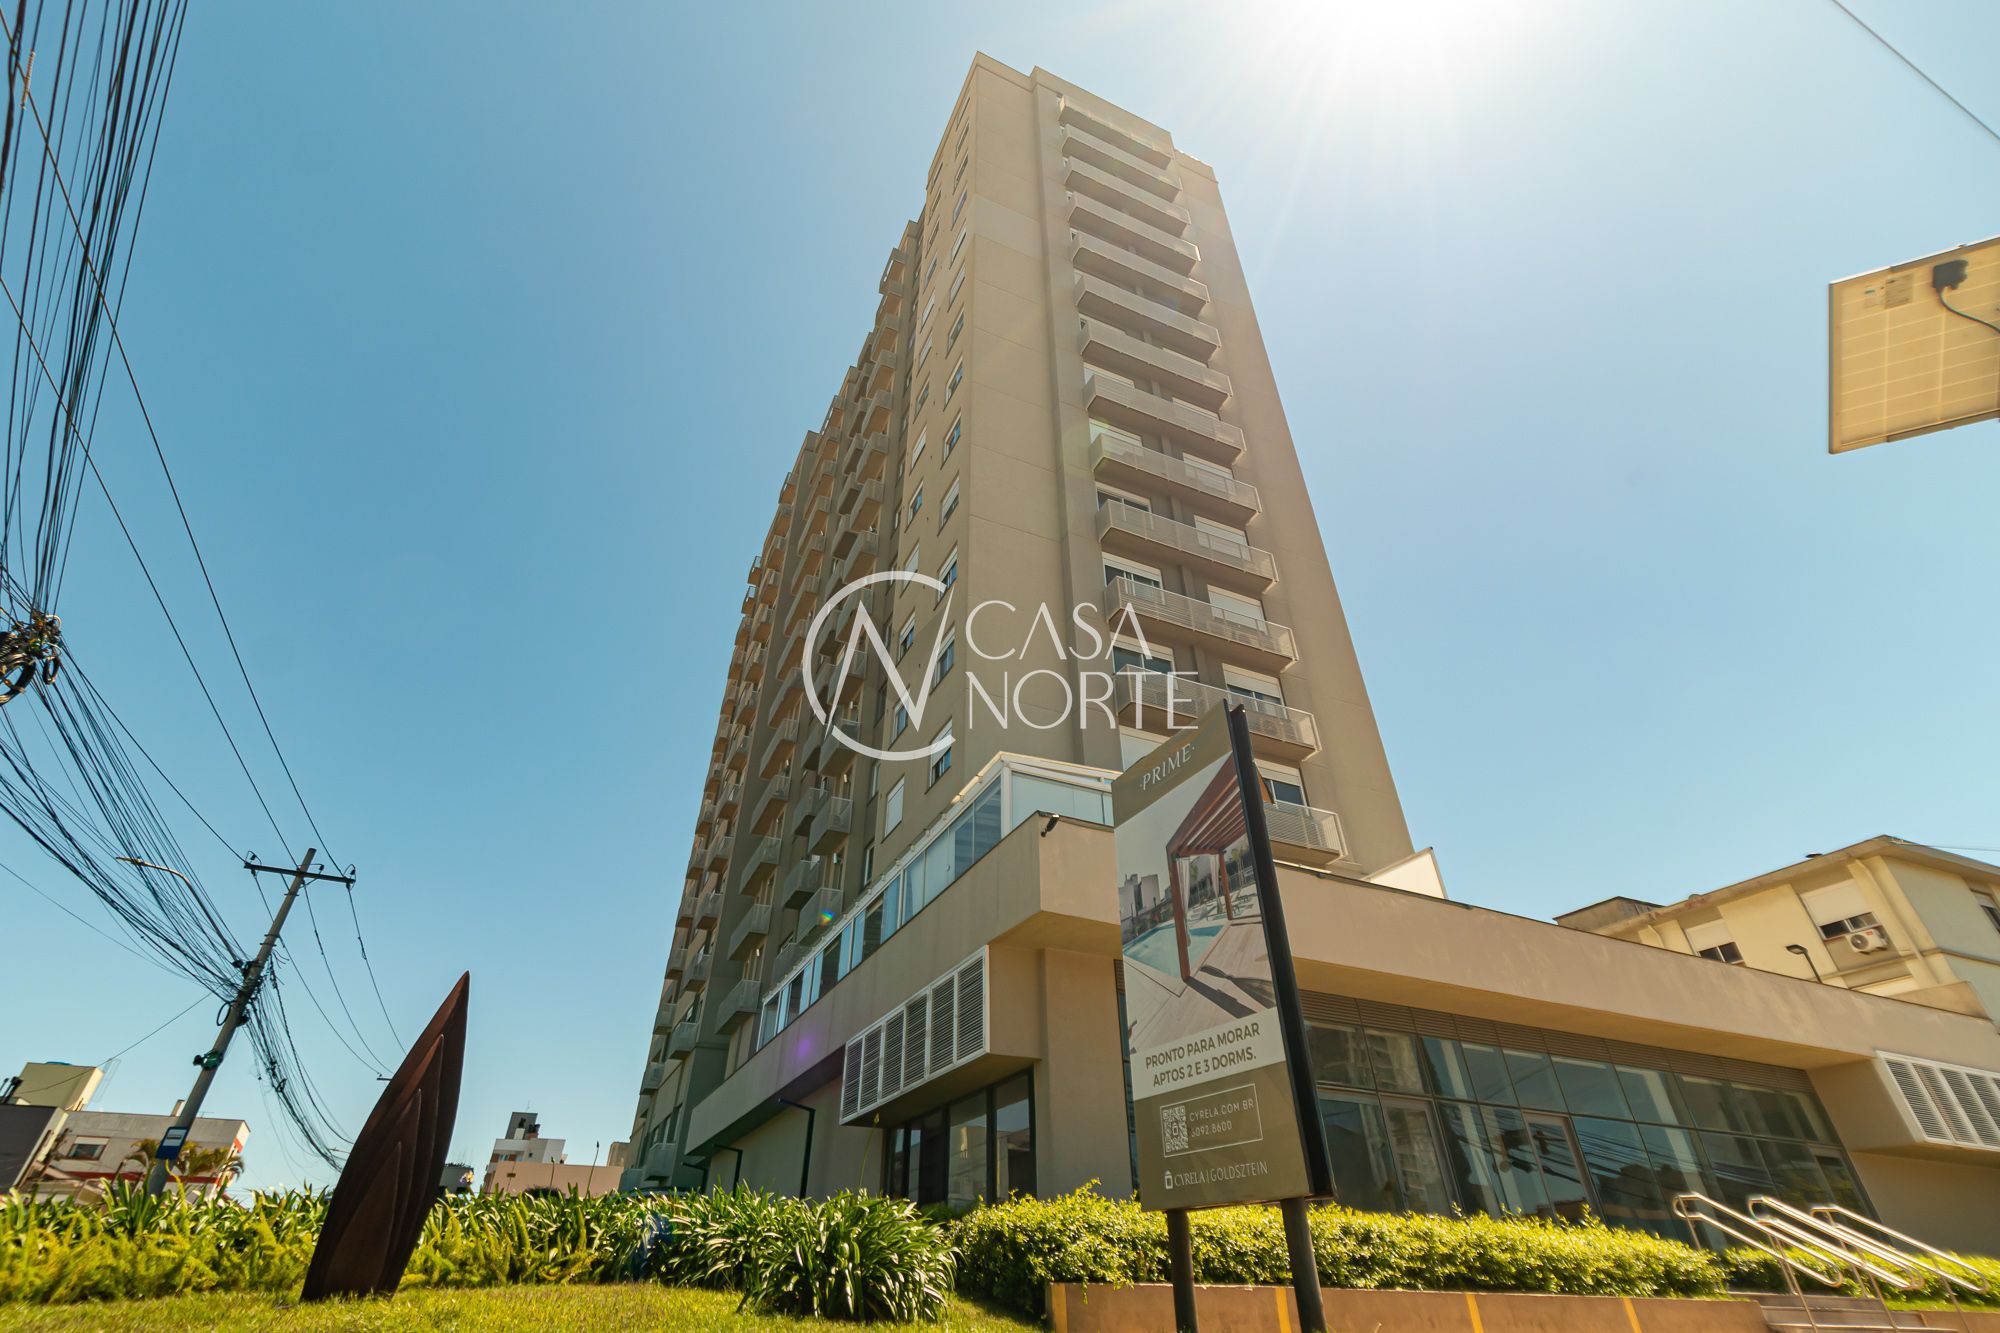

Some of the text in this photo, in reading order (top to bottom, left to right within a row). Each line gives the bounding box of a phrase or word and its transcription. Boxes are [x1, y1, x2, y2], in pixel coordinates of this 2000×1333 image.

[1145, 1022, 1260, 1070] PRONTO PARA MORAR
[1153, 1046, 1257, 1088] APTOS 2 E 3 DORMS.
[1174, 1160, 1268, 1187] CYRELA GOLDSZTEIN
